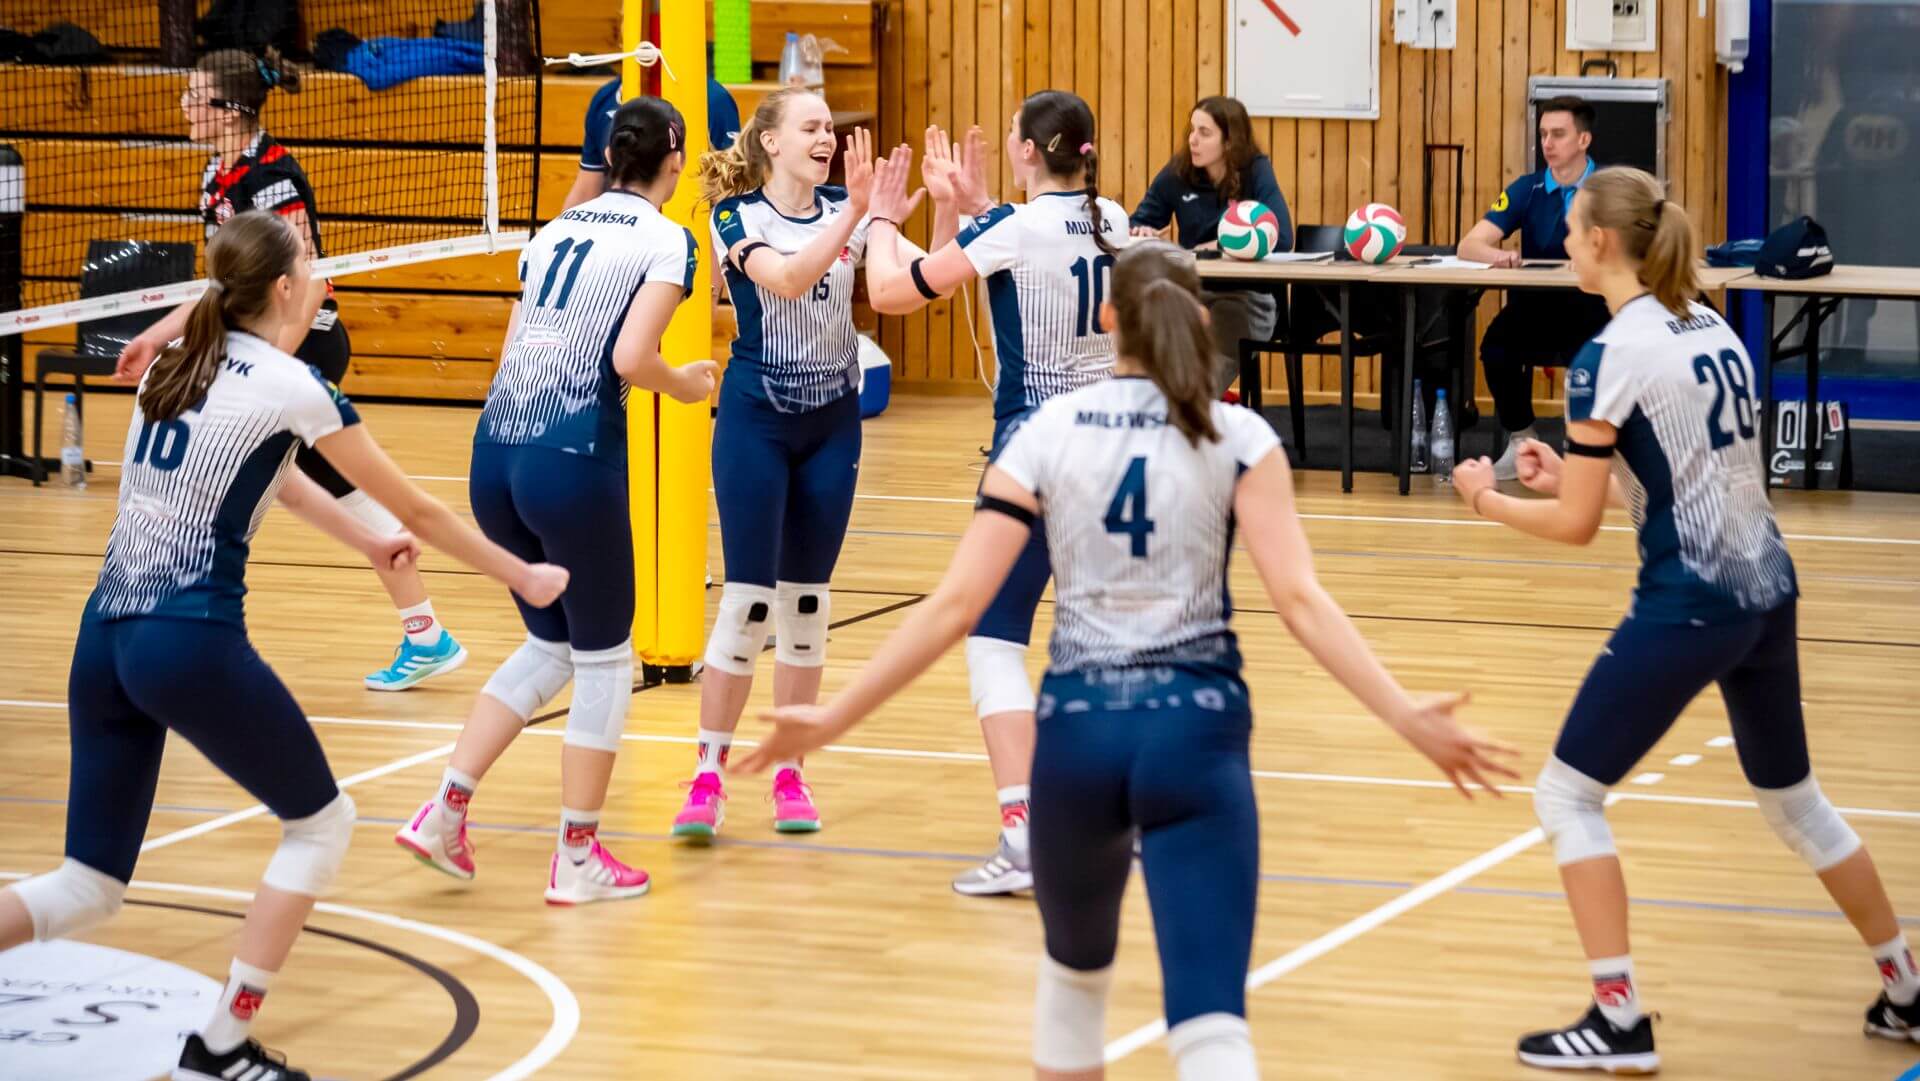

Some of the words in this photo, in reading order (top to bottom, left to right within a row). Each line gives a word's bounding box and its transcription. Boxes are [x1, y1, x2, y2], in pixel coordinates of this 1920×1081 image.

[561, 209, 639, 228] OSZYŃSKA
[1065, 218, 1113, 235] MULA
[536, 236, 595, 311] 11
[1075, 409, 1169, 429] MILEWS
[1692, 347, 1755, 450] 28
[1103, 456, 1155, 559] 4
